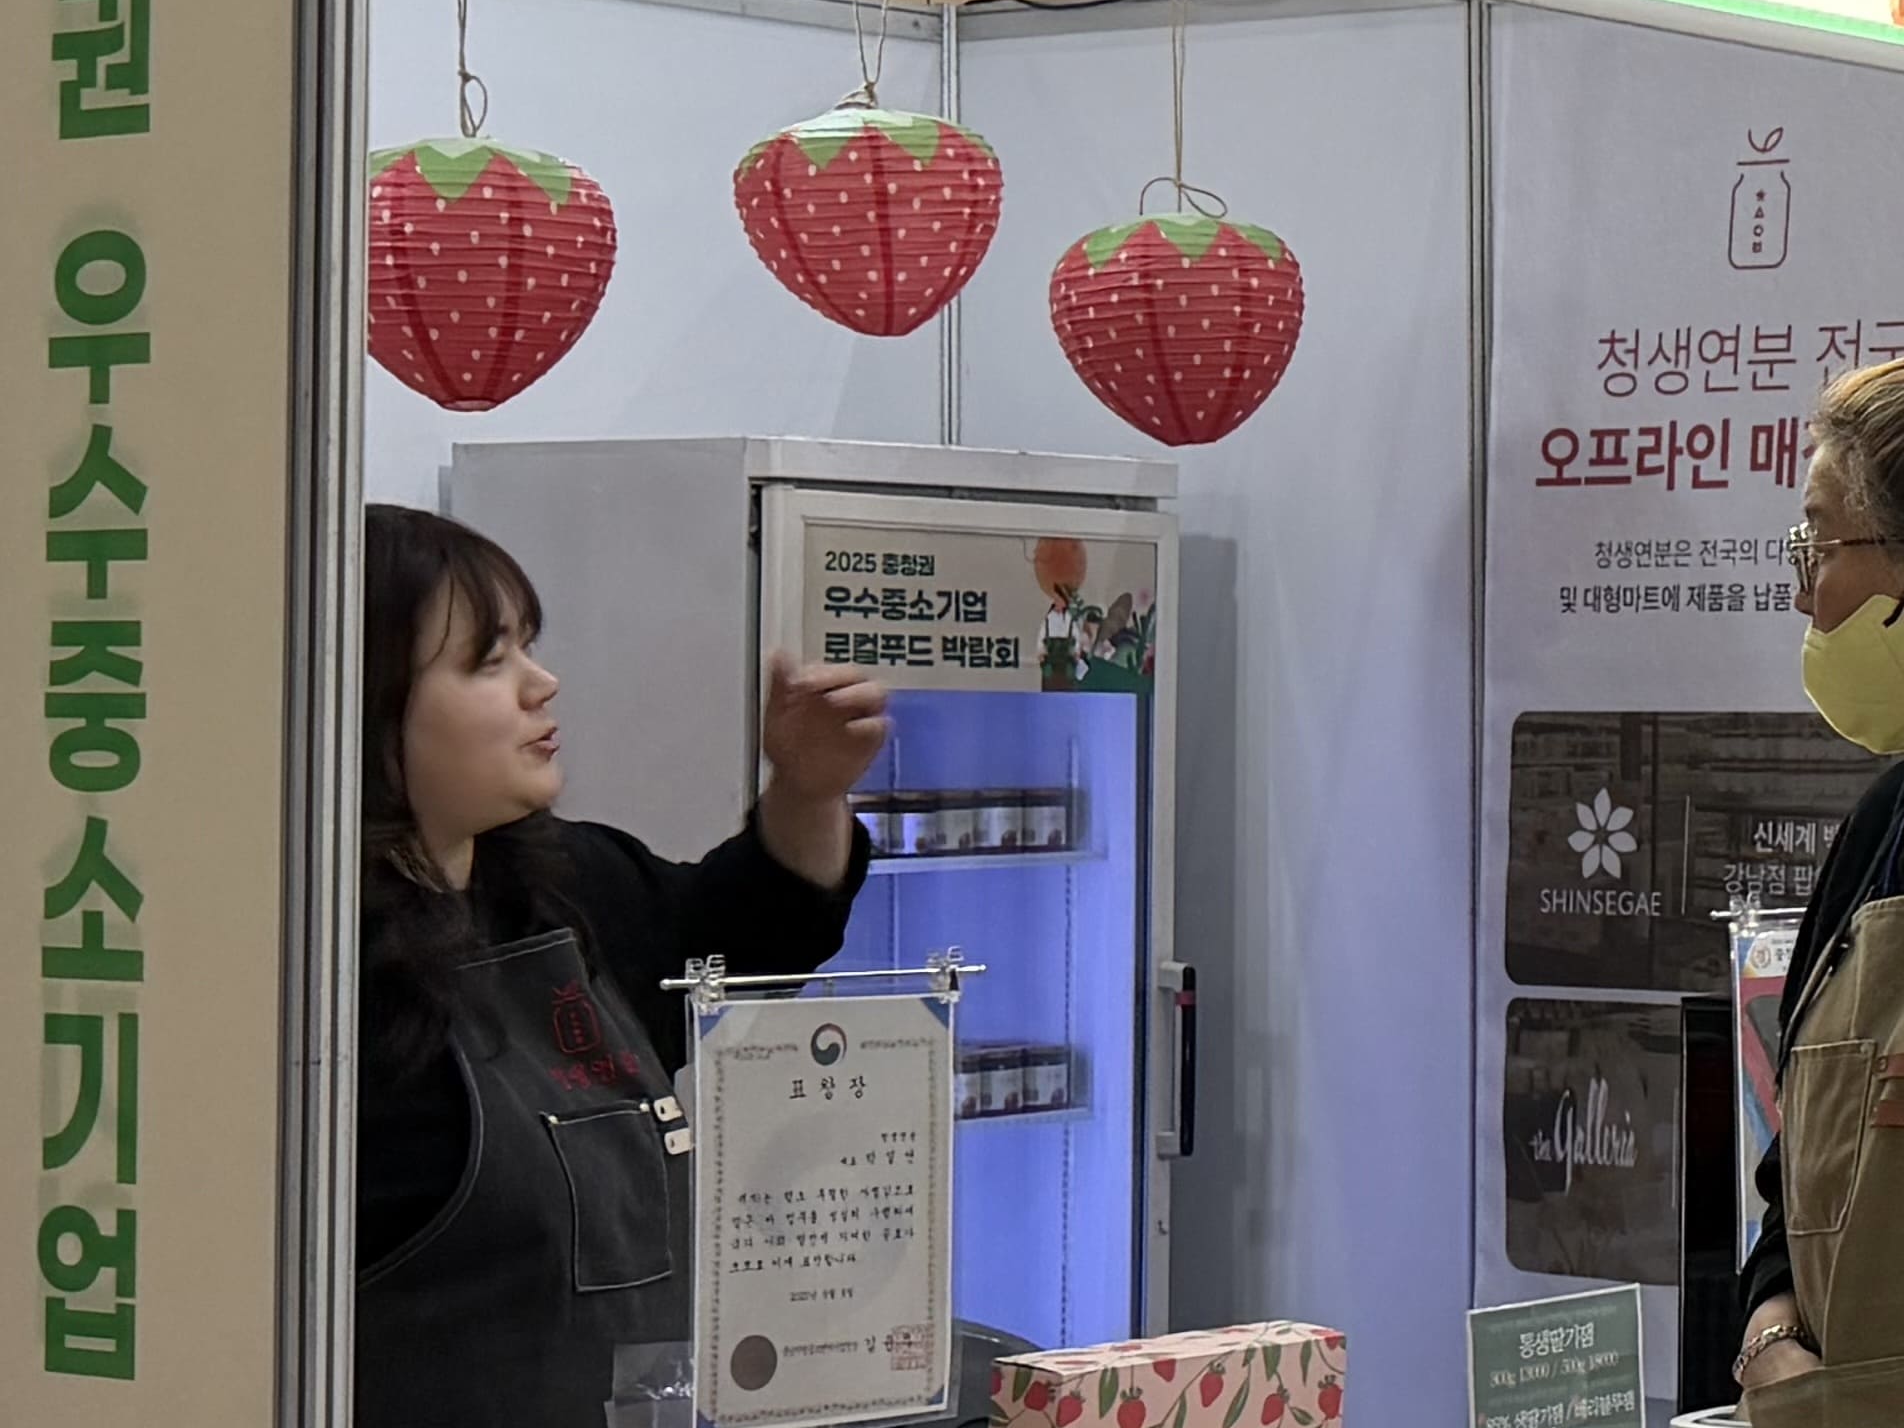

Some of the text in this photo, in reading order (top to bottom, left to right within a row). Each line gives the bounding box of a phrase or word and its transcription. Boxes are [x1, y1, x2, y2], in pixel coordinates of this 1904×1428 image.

[1596, 323, 1797, 397] 청생연분
[1535, 416, 1815, 491] 오프라인 매
[825, 550, 877, 573] 2025
[1699, 538, 1759, 567] 전국의
[824, 585, 988, 623] 우수중소기업
[1583, 583, 1680, 613] 대형마트에
[1686, 583, 1745, 612] 제품을
[824, 632, 1020, 669] 로컬푸드 박람회
[36, 228, 151, 1381] 우수중소기업
[1754, 821, 1815, 854] 신세계
[1540, 888, 1661, 917] SHINSEGAE
